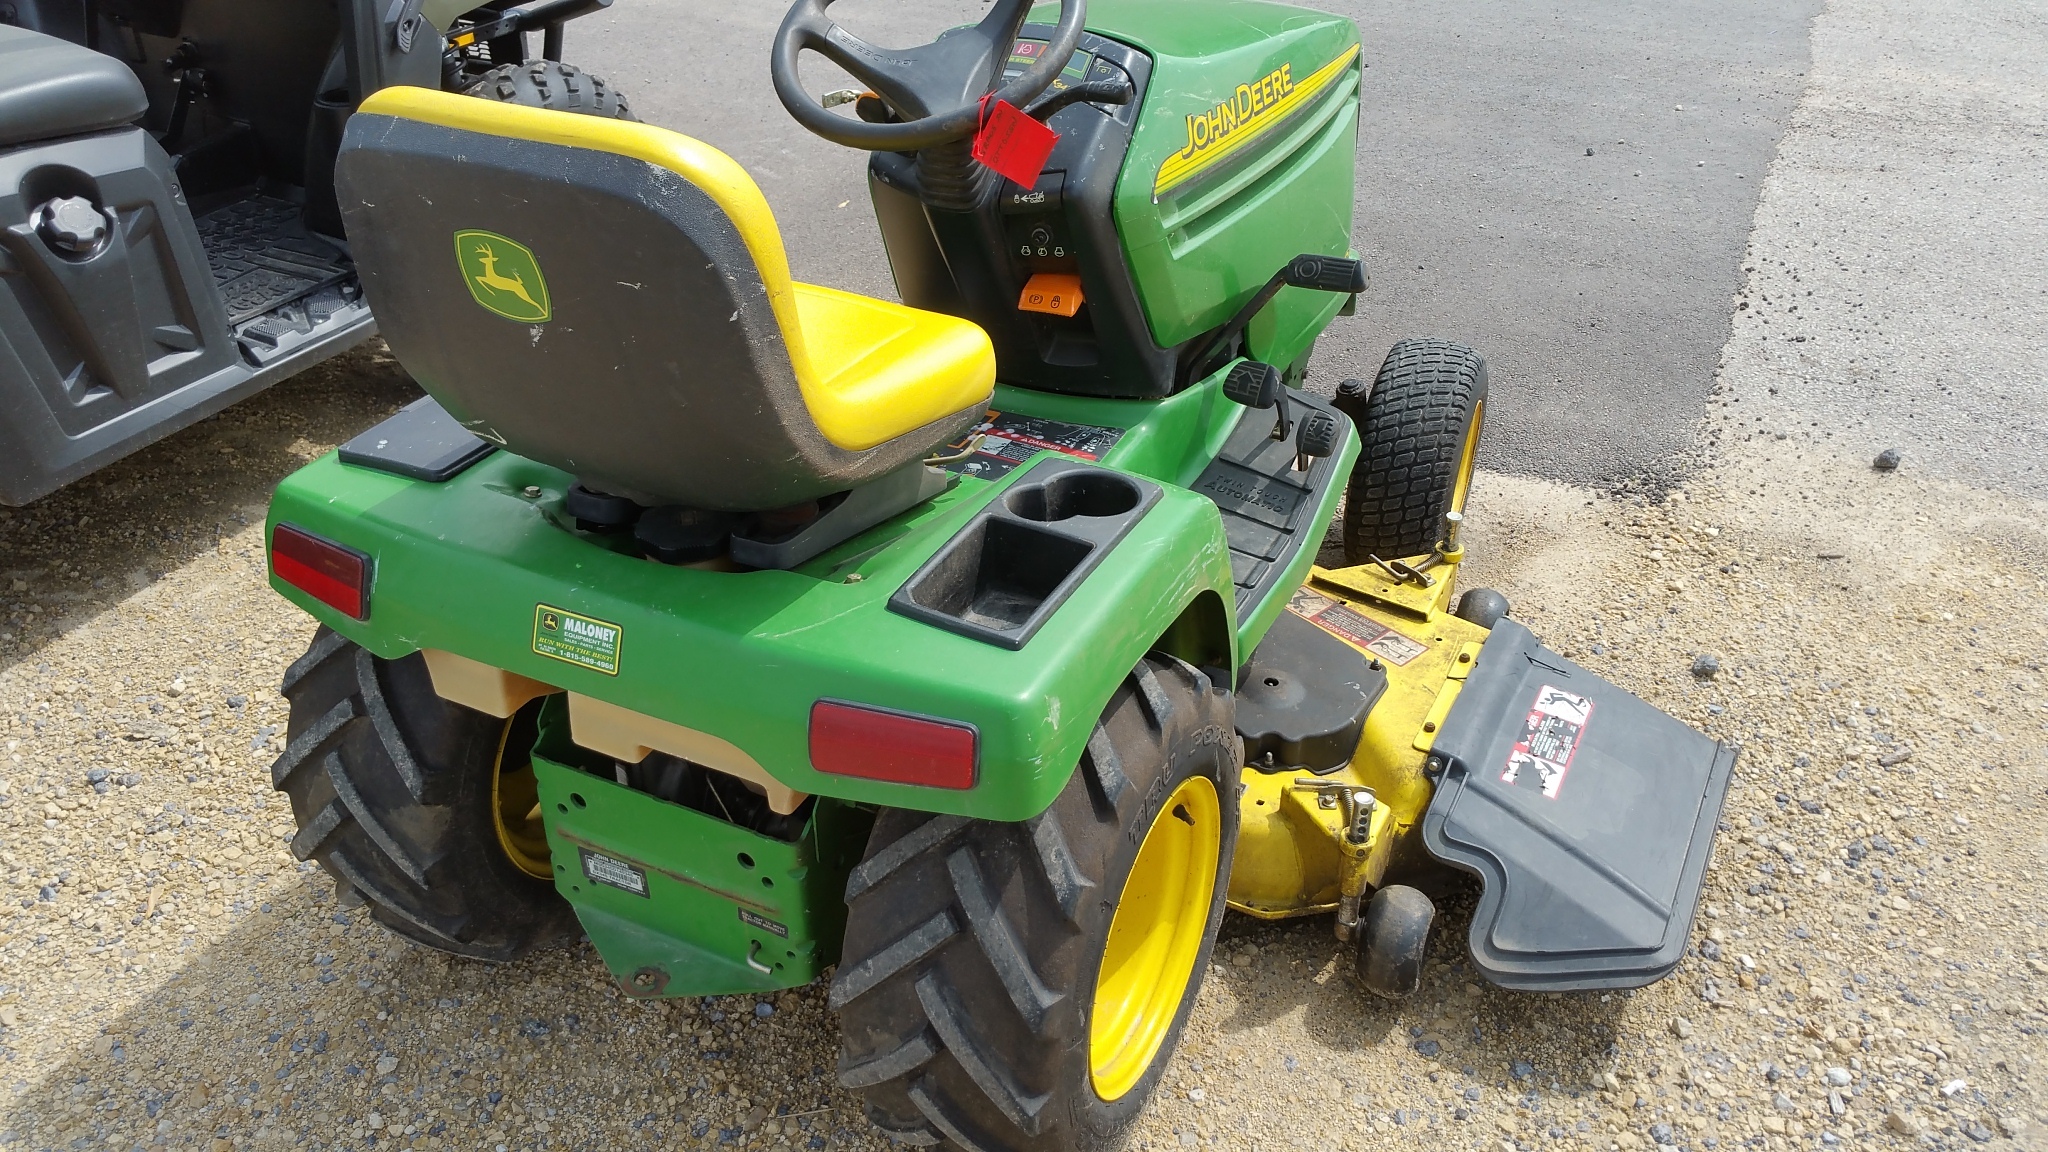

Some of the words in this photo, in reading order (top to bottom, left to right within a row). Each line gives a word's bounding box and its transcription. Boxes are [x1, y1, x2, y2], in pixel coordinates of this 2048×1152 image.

[841, 35, 883, 62] DEERE
[1181, 97, 1236, 159] JOHN
[1235, 62, 1294, 123] DEERE
[1028, 438, 1062, 451] DANGER
[1204, 481, 1284, 513] AUTOMATIC
[1249, 486, 1288, 503] TOUCH
[564, 618, 616, 642] MALONEY
[1317, 619, 1352, 638] DANGER
[538, 637, 554, 646] RUN
[556, 641, 575, 651] WITH
[576, 647, 591, 656] THE
[564, 631, 601, 646] EQUIPMENT
[602, 641, 615, 650] INC.
[564, 637, 577, 645] SALES
[594, 853, 609, 862] JOHN
[610, 858, 629, 869] DEERE
